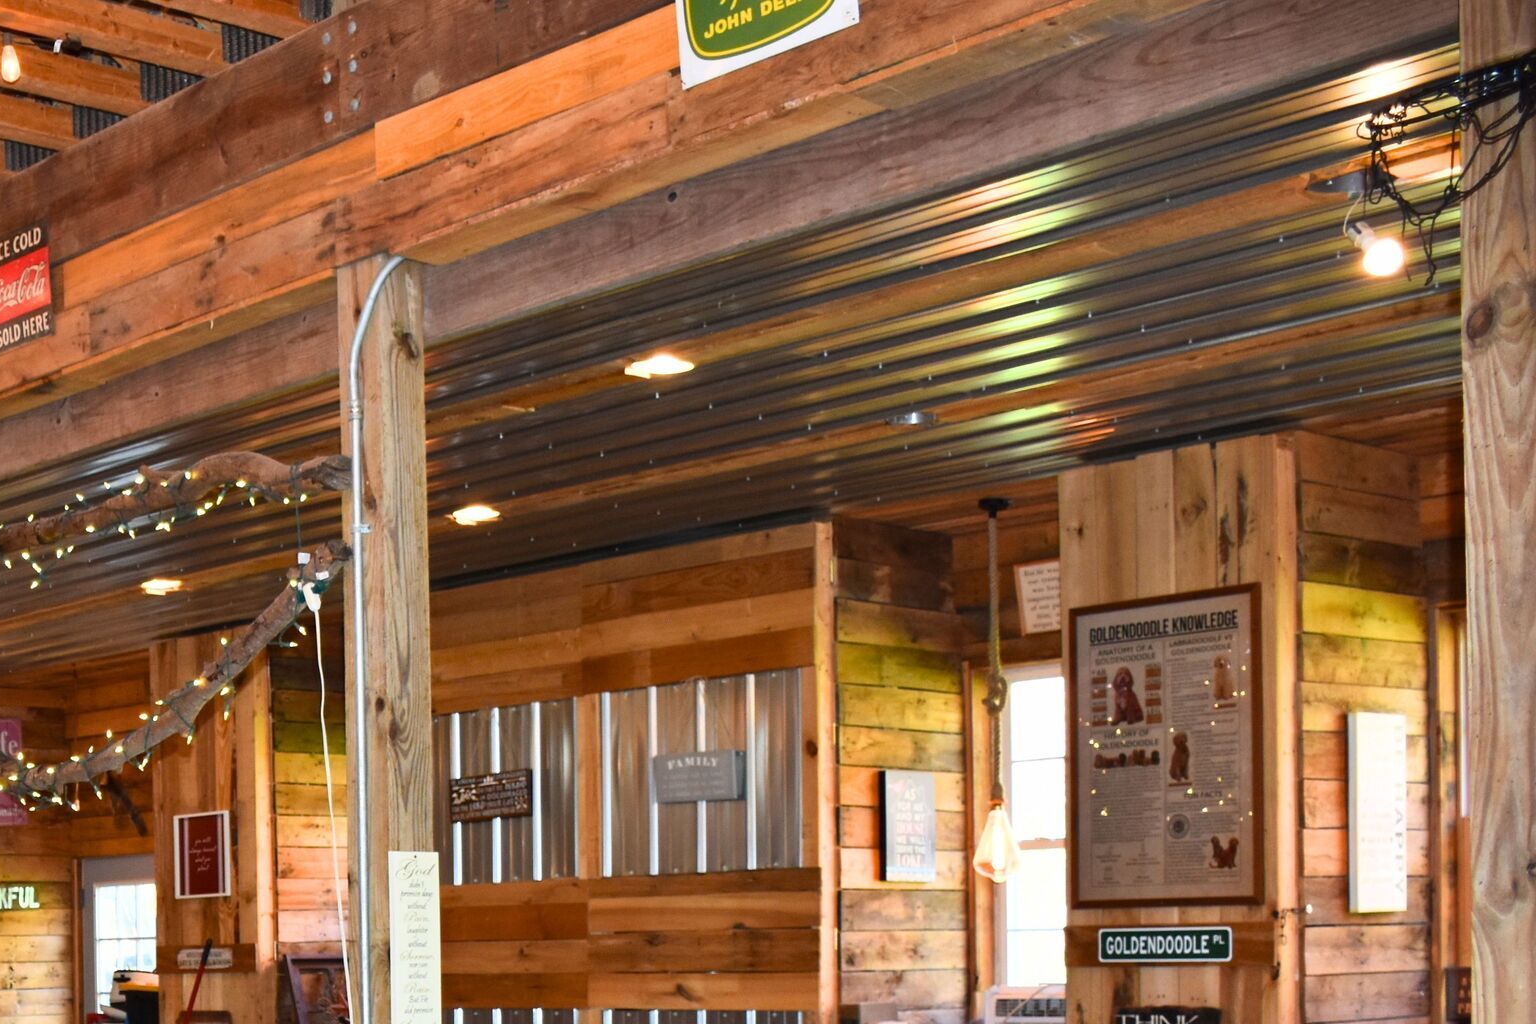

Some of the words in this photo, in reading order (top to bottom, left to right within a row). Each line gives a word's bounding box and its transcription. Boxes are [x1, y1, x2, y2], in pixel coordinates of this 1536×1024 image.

[704, 8, 753, 39] JOHN
[13, 227, 41, 253] COLD
[23, 312, 49, 338] HERE
[1090, 619, 1168, 643] GOLDENDOODLE
[1172, 610, 1238, 632] KNOWLEDGE
[667, 757, 718, 770] FAMILY
[396, 859, 435, 879] God
[1106, 935, 1209, 954] GOLDENDOODLE
[1213, 935, 1225, 944] PL
